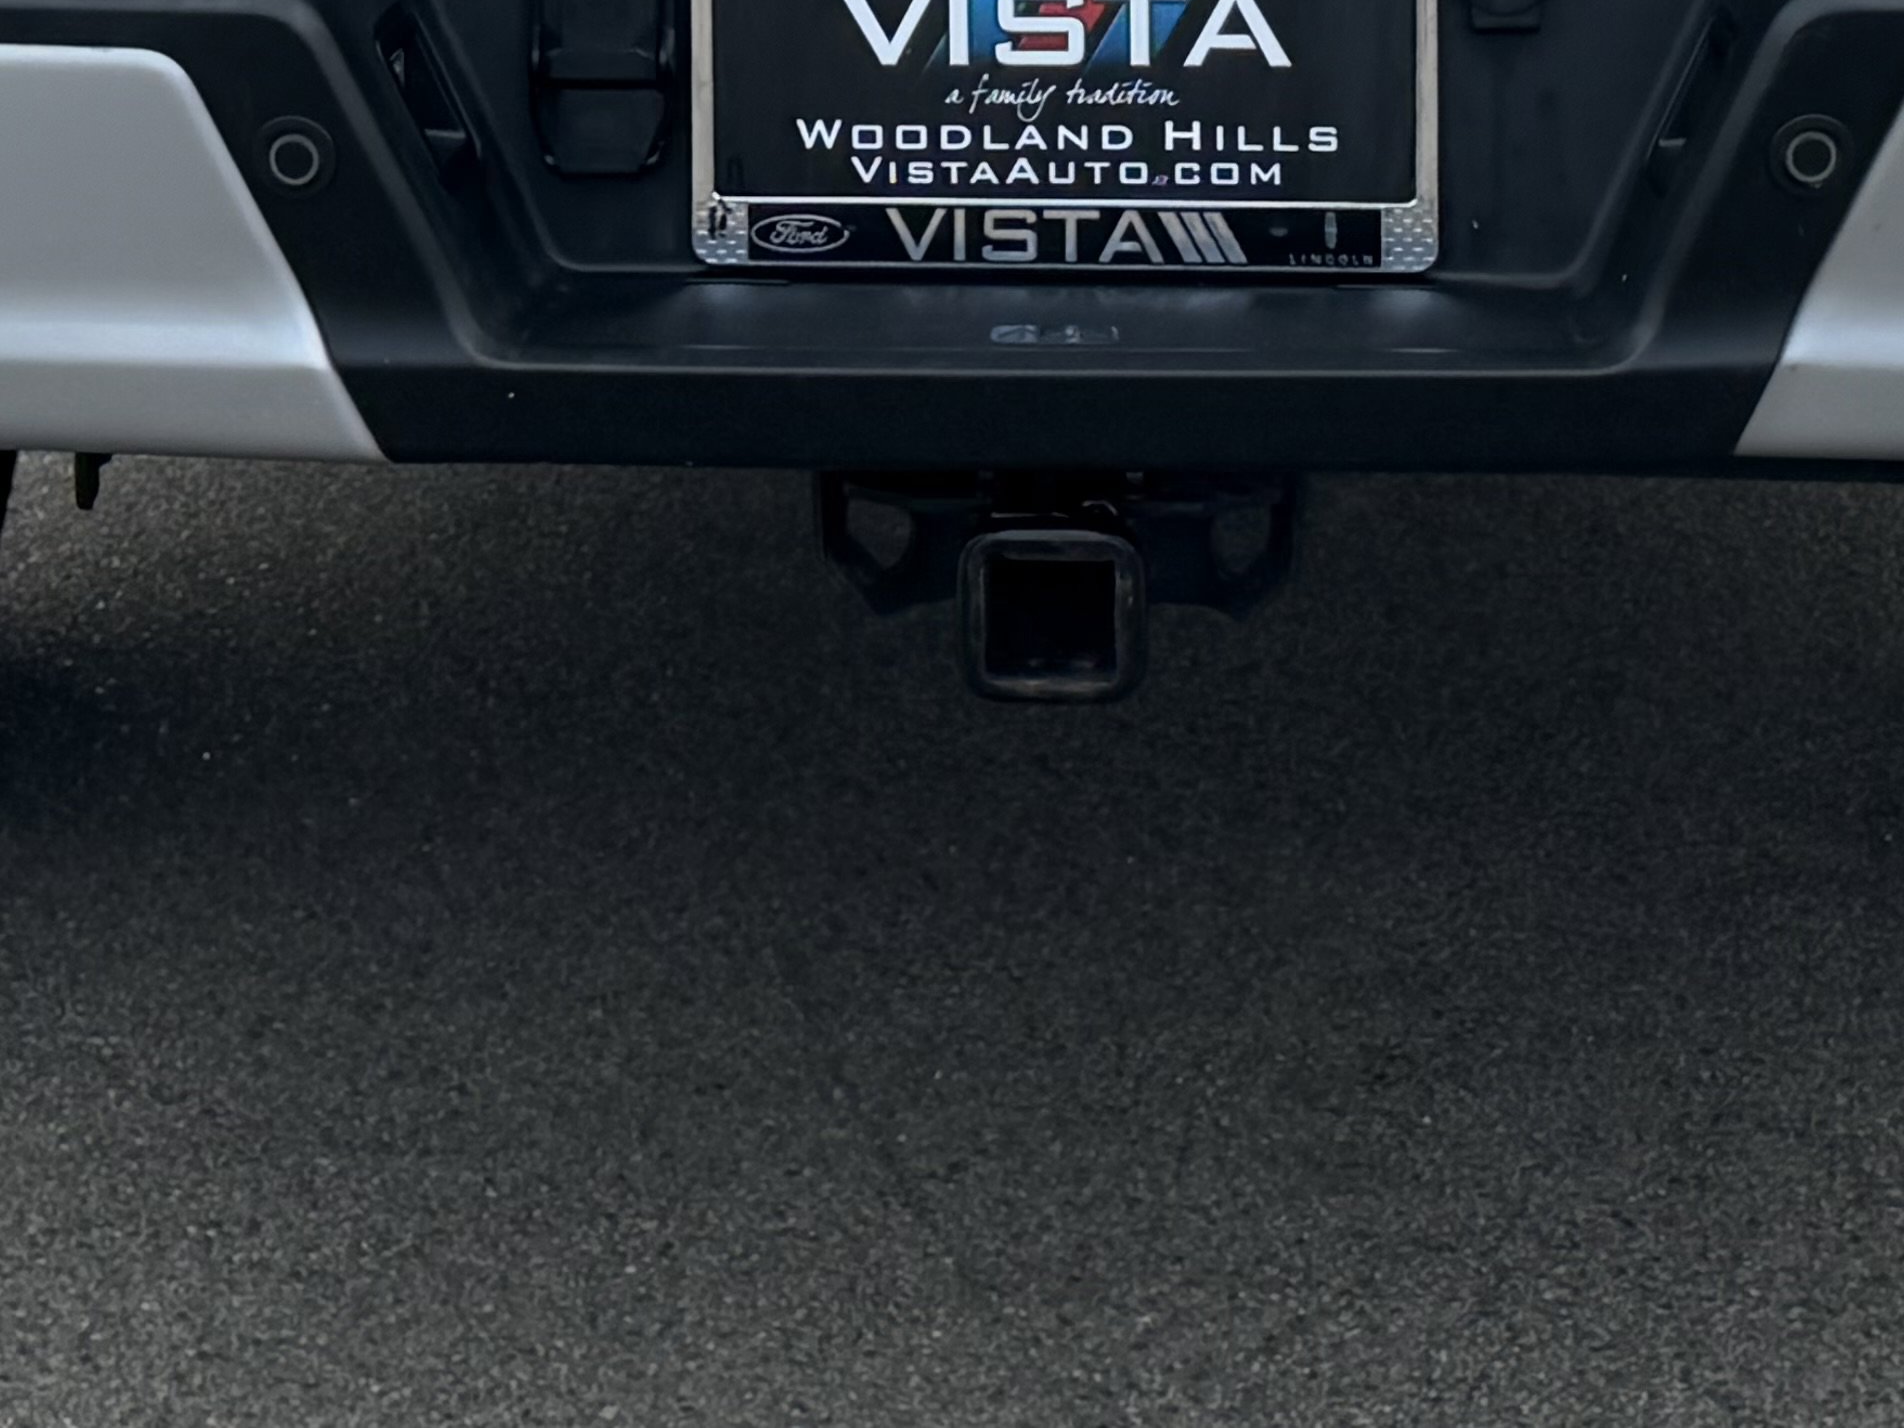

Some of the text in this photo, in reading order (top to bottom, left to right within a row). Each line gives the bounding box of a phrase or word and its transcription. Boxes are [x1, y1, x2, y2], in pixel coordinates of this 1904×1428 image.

[944, 73, 1181, 123] a family tradition
[795, 118, 1339, 152] WOODLAND HILLS
[769, 207, 1165, 262] Ford VISTA
